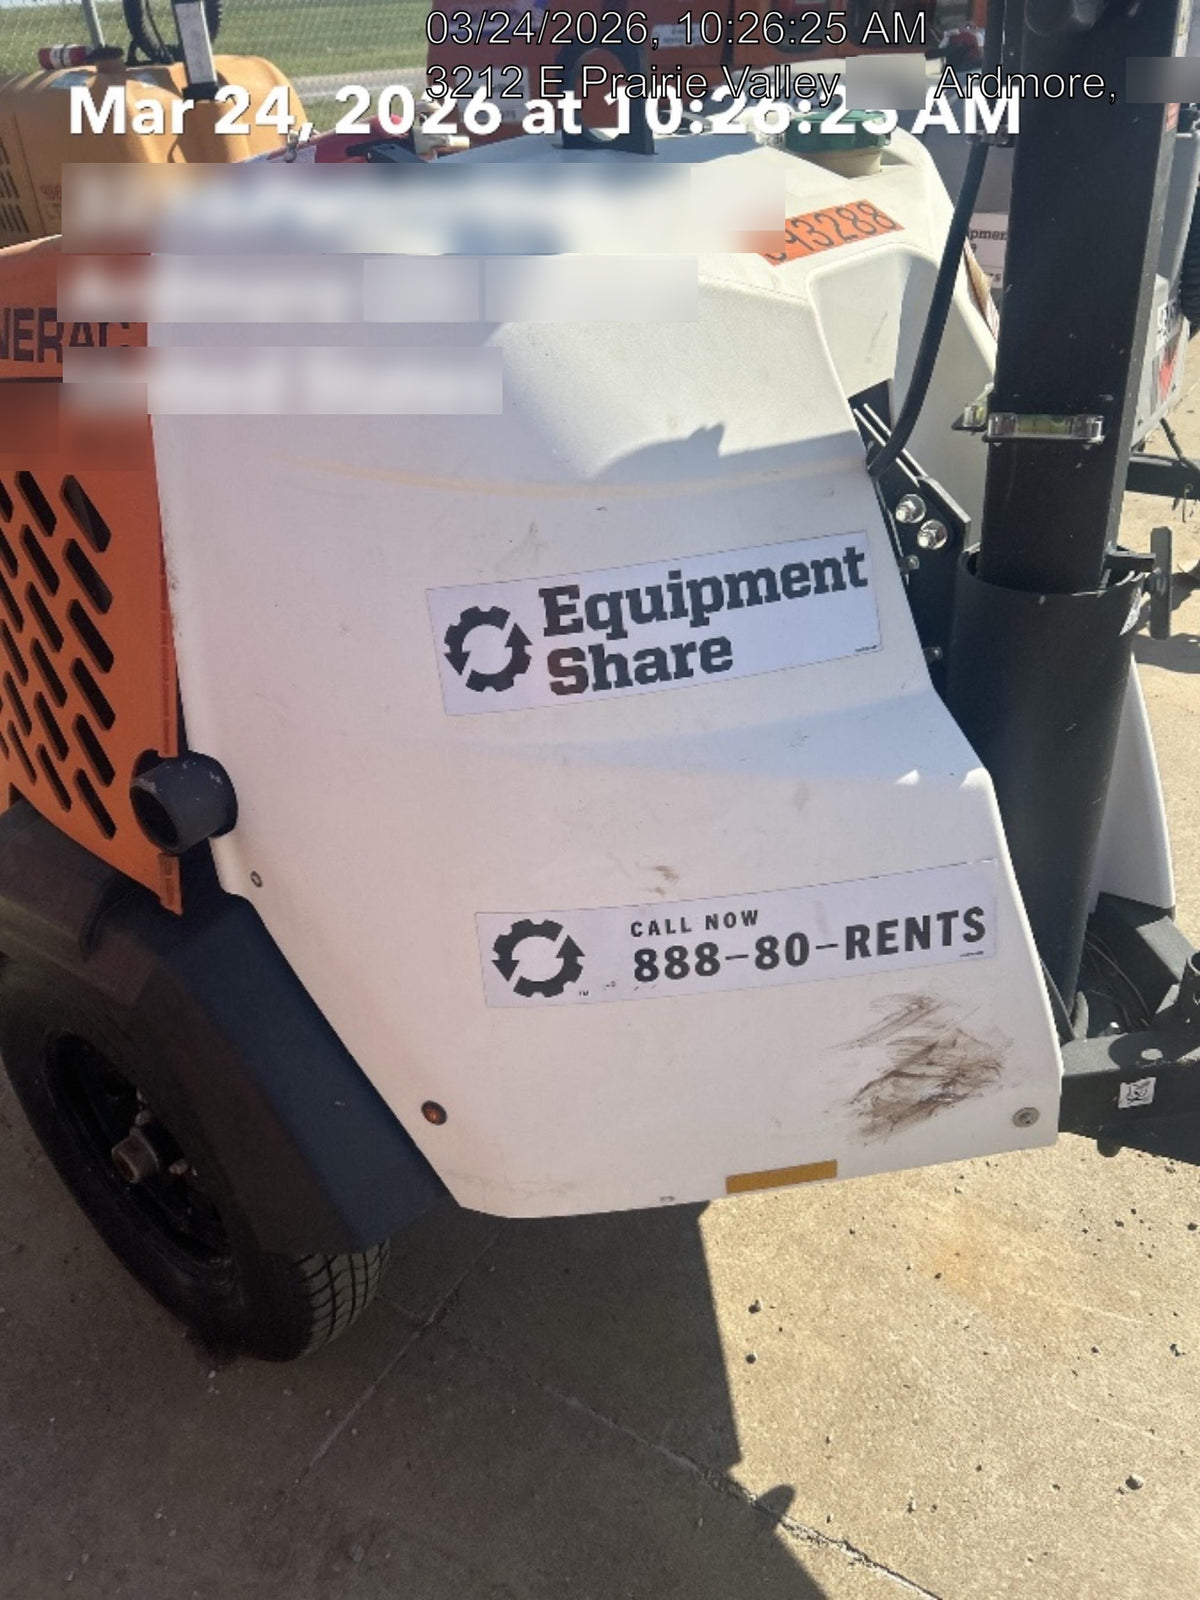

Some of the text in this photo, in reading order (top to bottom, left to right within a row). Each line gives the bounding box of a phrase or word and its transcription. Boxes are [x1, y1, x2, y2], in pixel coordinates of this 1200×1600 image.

[538, 546, 868, 640] Equipment
[547, 636, 733, 696] Share
[631, 909, 760, 938] CALL NOW
[634, 906, 986, 983] 888-80-RENTS
